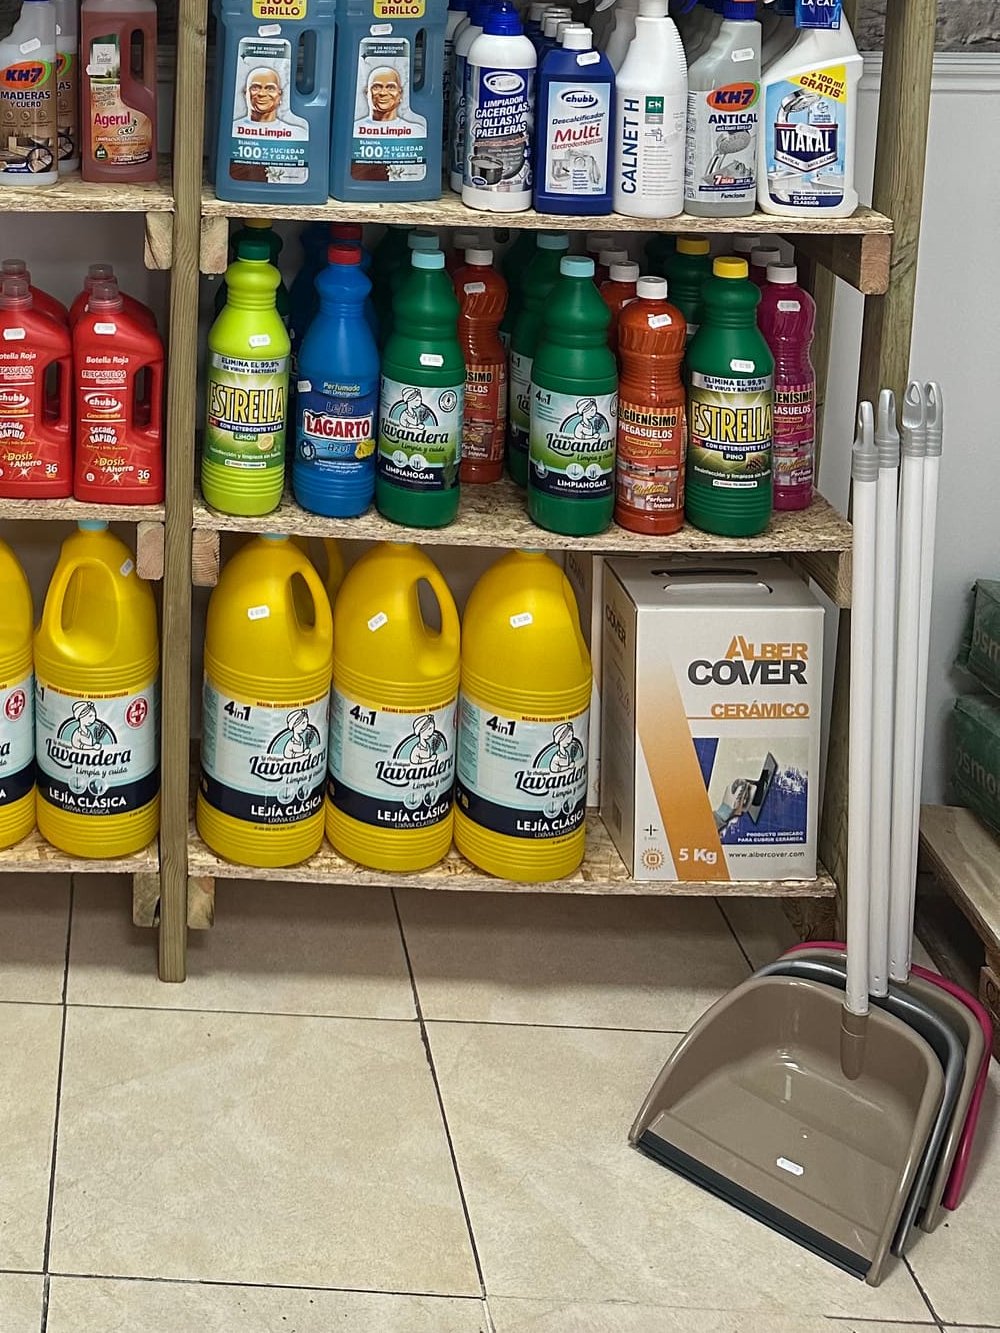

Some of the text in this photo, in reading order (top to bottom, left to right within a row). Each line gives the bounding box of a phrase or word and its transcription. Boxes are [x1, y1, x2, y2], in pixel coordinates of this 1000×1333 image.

[260, 5, 300, 16] BRILLO
[381, 5, 419, 15] BRILLO
[0, 90, 51, 101] MADERAS
[800, 76, 842, 98] GRATIS
[17, 100, 42, 108] CUERO
[565, 94, 595, 104] chubb
[94, 112, 130, 128] Agerul
[708, 113, 758, 124] ANTICAL
[237, 127, 292, 139] Don Limpio
[359, 126, 412, 137] Don Limpio
[476, 122, 526, 139] PAELLERAS
[554, 124, 600, 143] Multi
[622, 98, 639, 194] CALNET H
[780, 130, 832, 153] VIAKAL
[20, 351, 37, 360] Roja
[82, 370, 126, 379] FRIEGASUELOS
[209, 381, 285, 423] ESTRELLA
[306, 416, 370, 437] LAGARTO
[691, 400, 773, 443] ESTRELLA
[382, 418, 449, 444] Lavandera
[726, 453, 744, 461] PINO
[137, 470, 150, 479] 36
[386, 465, 434, 480] LIMPIAHOGAR
[557, 479, 607, 489] LIMPIAHOGAR
[725, 635, 809, 661] ALBER
[687, 659, 808, 685] COVER
[224, 701, 251, 721] 4in1
[349, 706, 377, 726] 4in1
[711, 700, 809, 718] CERÁMICO
[486, 715, 516, 736] 4in1
[46, 738, 131, 768] Lavandera
[49, 787, 127, 808] LEJÍA CLÁSICA
[251, 796, 322, 817] LEJÍA CLÁSICA
[377, 802, 449, 823] LEJÍA CLÁSICA
[517, 818, 549, 832] LEJÍA
[678, 848, 718, 865] 5 Kg
[728, 850, 805, 859] www.albercover.com
